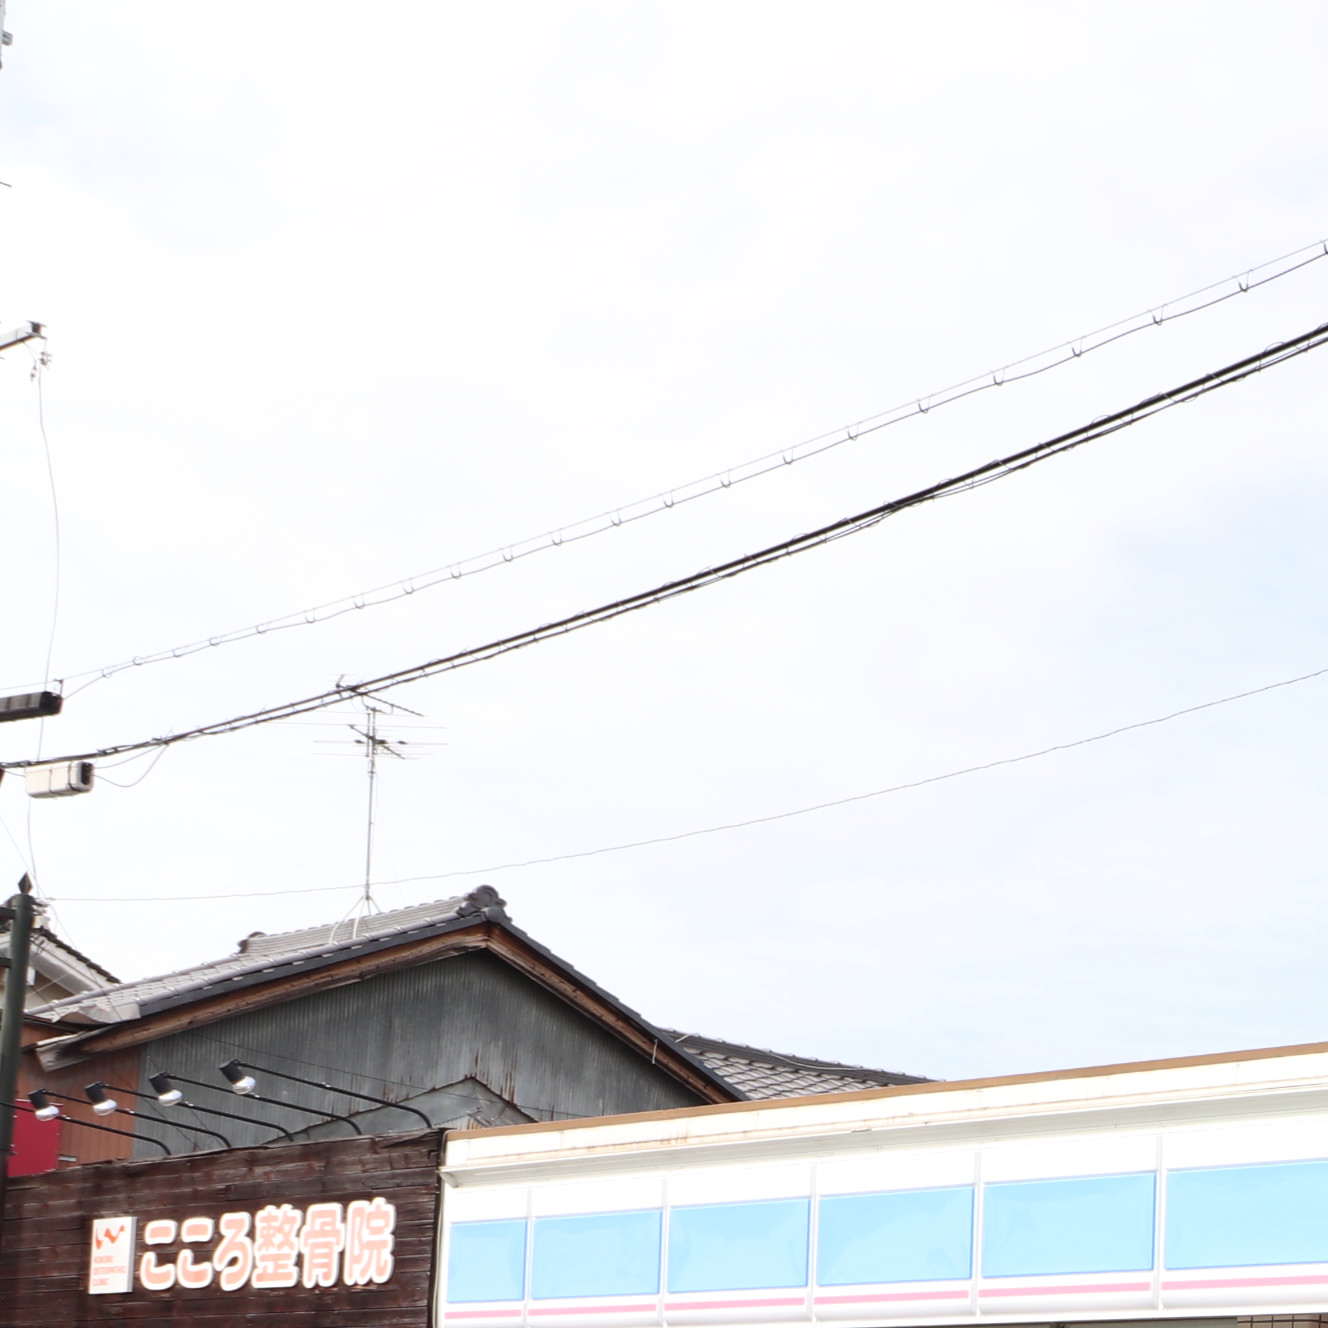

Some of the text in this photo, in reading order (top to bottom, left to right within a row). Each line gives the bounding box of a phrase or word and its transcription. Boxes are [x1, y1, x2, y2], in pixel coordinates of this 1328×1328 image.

[143, 1198, 395, 1291] こころ整骨院
